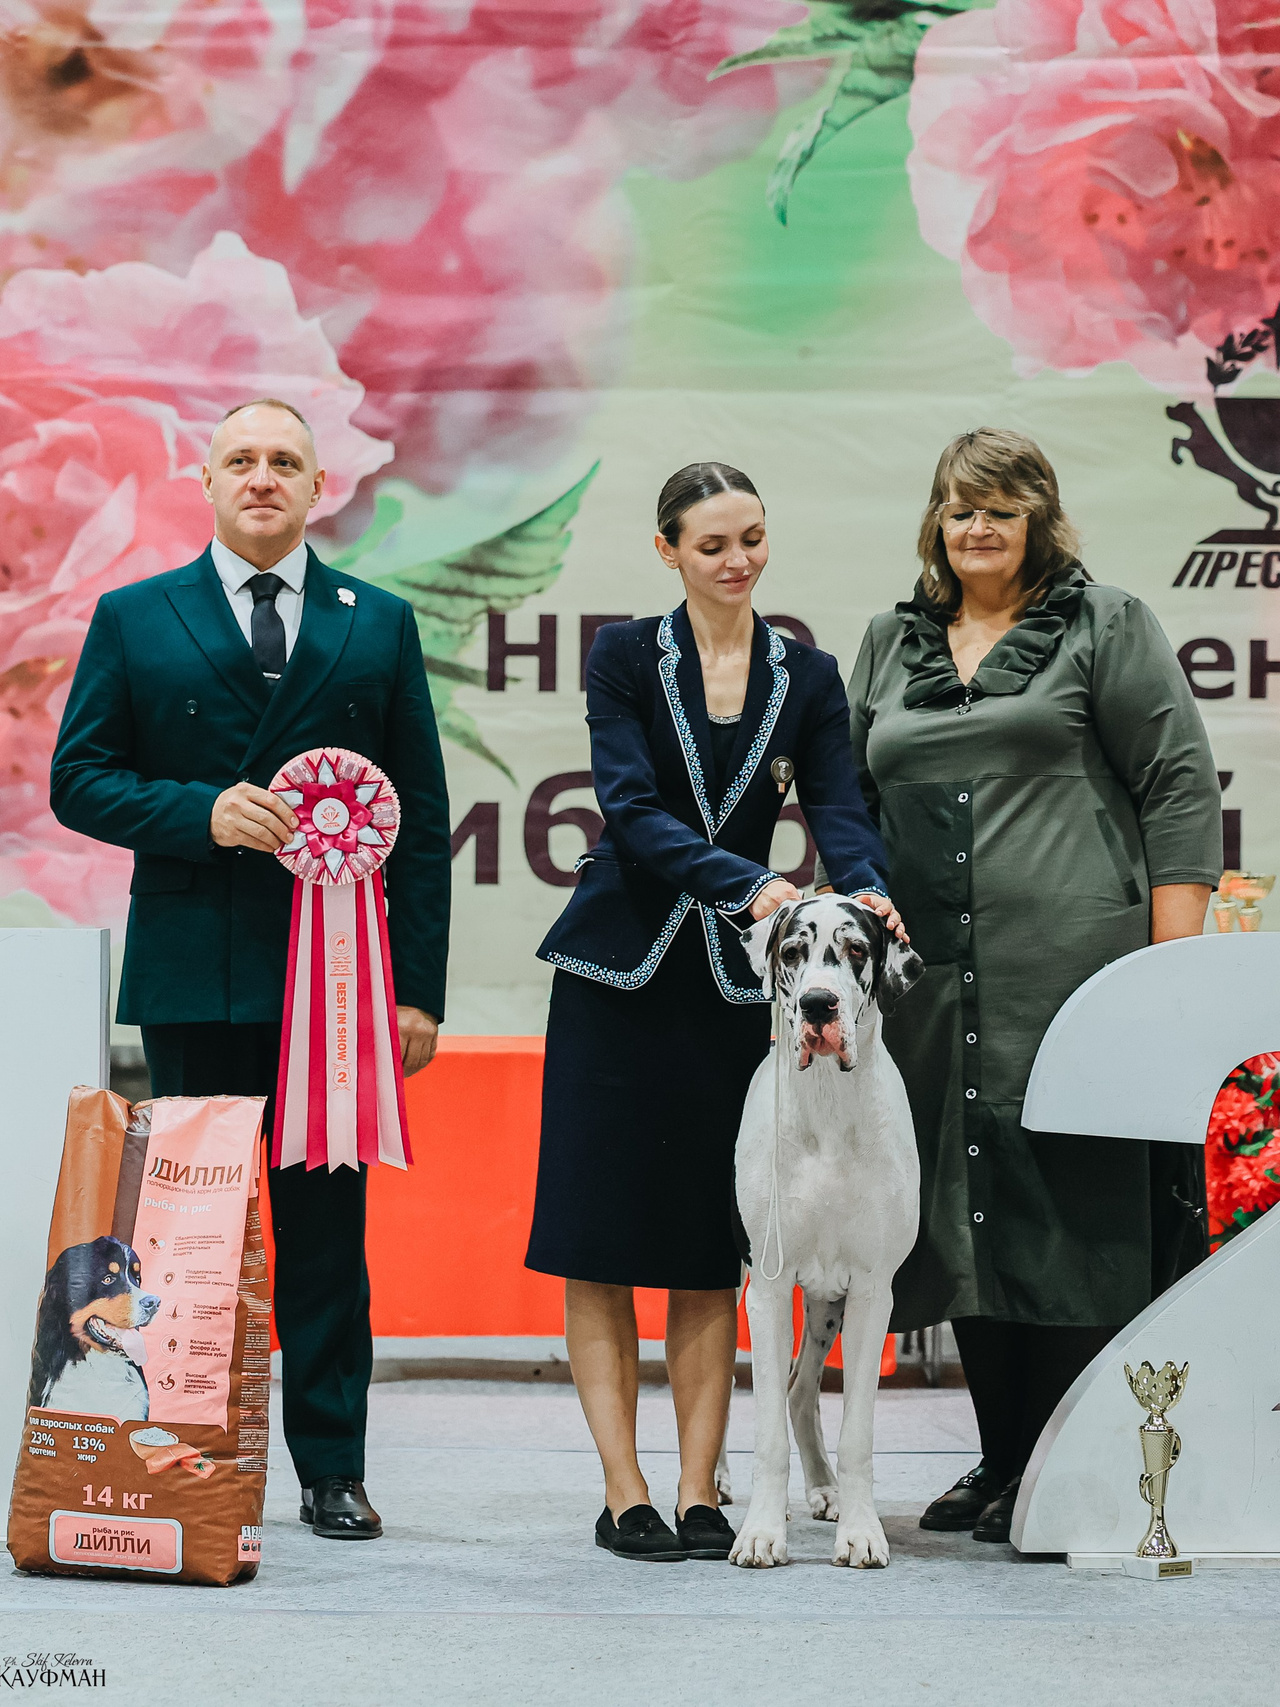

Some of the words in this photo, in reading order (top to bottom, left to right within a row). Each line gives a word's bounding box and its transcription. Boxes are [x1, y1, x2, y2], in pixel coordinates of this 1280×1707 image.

[336, 982, 347, 1010] BEST
[336, 1013, 347, 1024] IN
[336, 1027, 347, 1061] SHOW
[337, 1071, 347, 1083] 2
[148, 1157, 243, 1186] ДИЛЛИ
[144, 1196, 175, 1212] рыба
[179, 1204, 188, 1213] и
[191, 1203, 212, 1215] рис
[40, 1419, 82, 1431] взрослых
[84, 1423, 115, 1434] собак
[30, 1430, 55, 1447] 23%
[72, 1436, 106, 1452] 13%
[28, 1446, 56, 1457] протеин
[77, 1453, 97, 1464] жир
[82, 1484, 114, 1508] 14
[122, 1492, 153, 1510] кг
[73, 1533, 151, 1555] ДИЛЛИ
